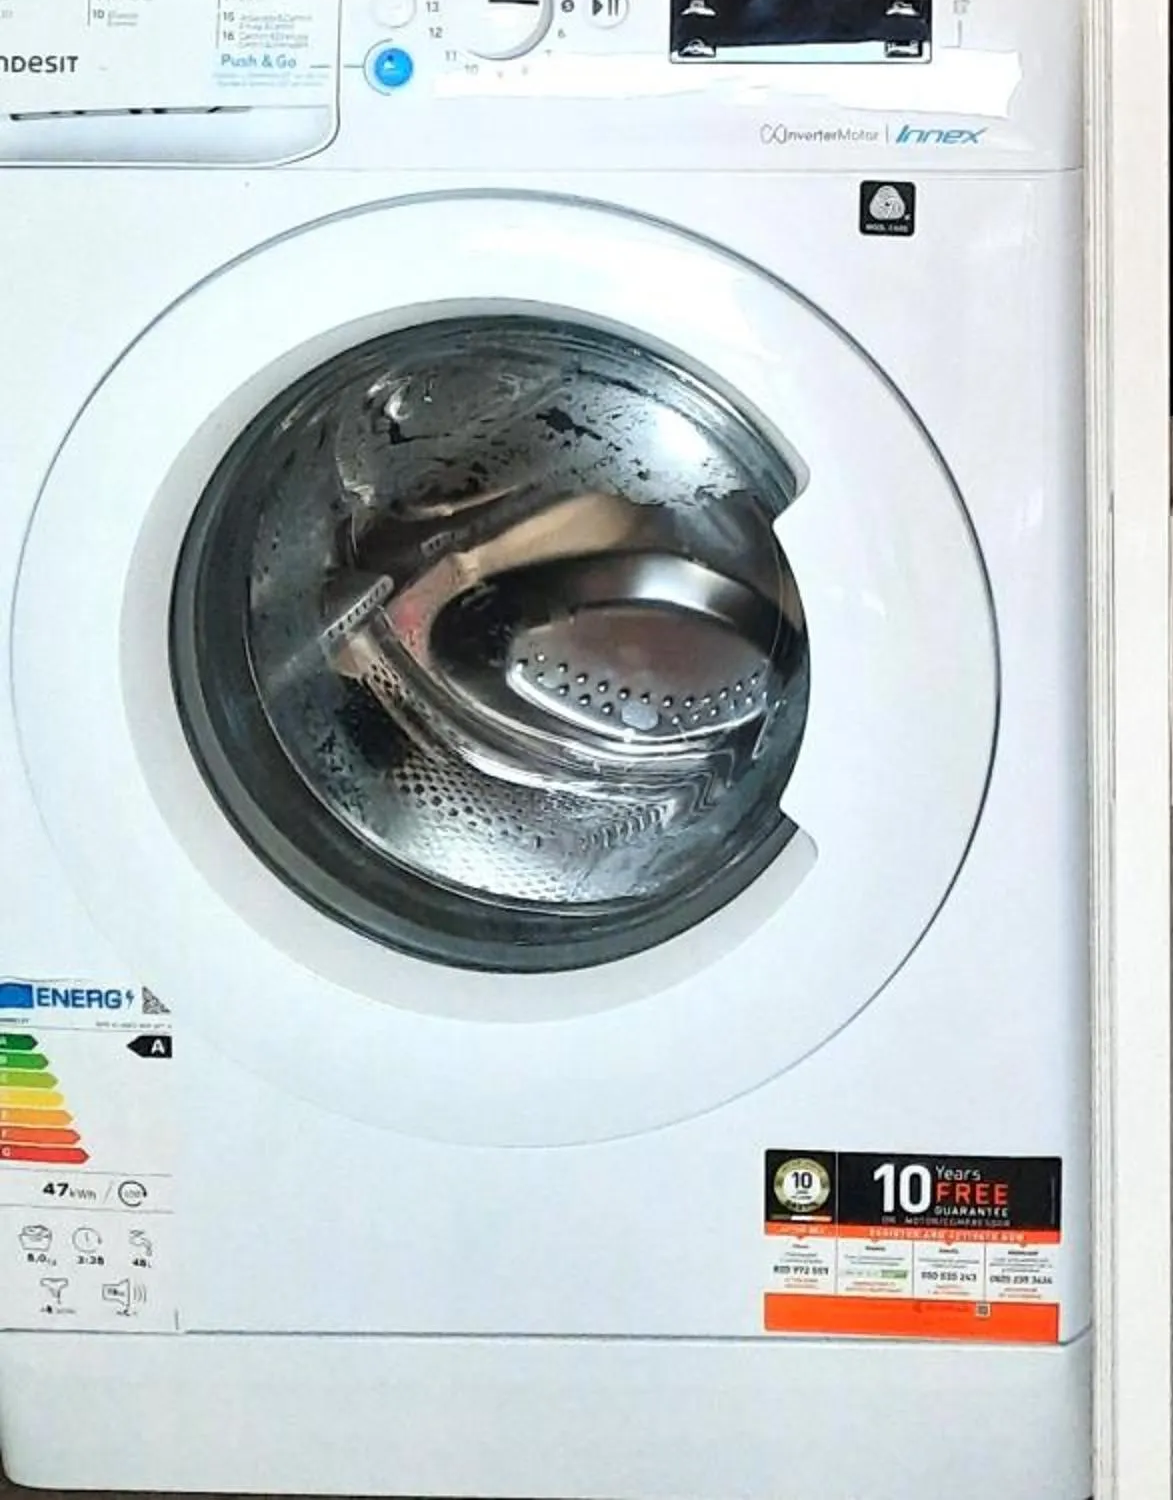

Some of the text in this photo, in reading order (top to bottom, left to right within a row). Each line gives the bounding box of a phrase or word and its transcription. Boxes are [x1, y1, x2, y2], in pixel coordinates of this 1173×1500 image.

[428, 26, 443, 39] 12
[221, 54, 297, 68] Push & Go
[896, 125, 988, 144] Innex
[37, 987, 122, 1009] ENERG
[151, 1038, 166, 1053] A
[791, 1172, 813, 1189] 10
[873, 1163, 981, 1214] 10 Years
[43, 1182, 97, 1200] 47 kWh
[936, 1183, 1009, 1205] FREE
